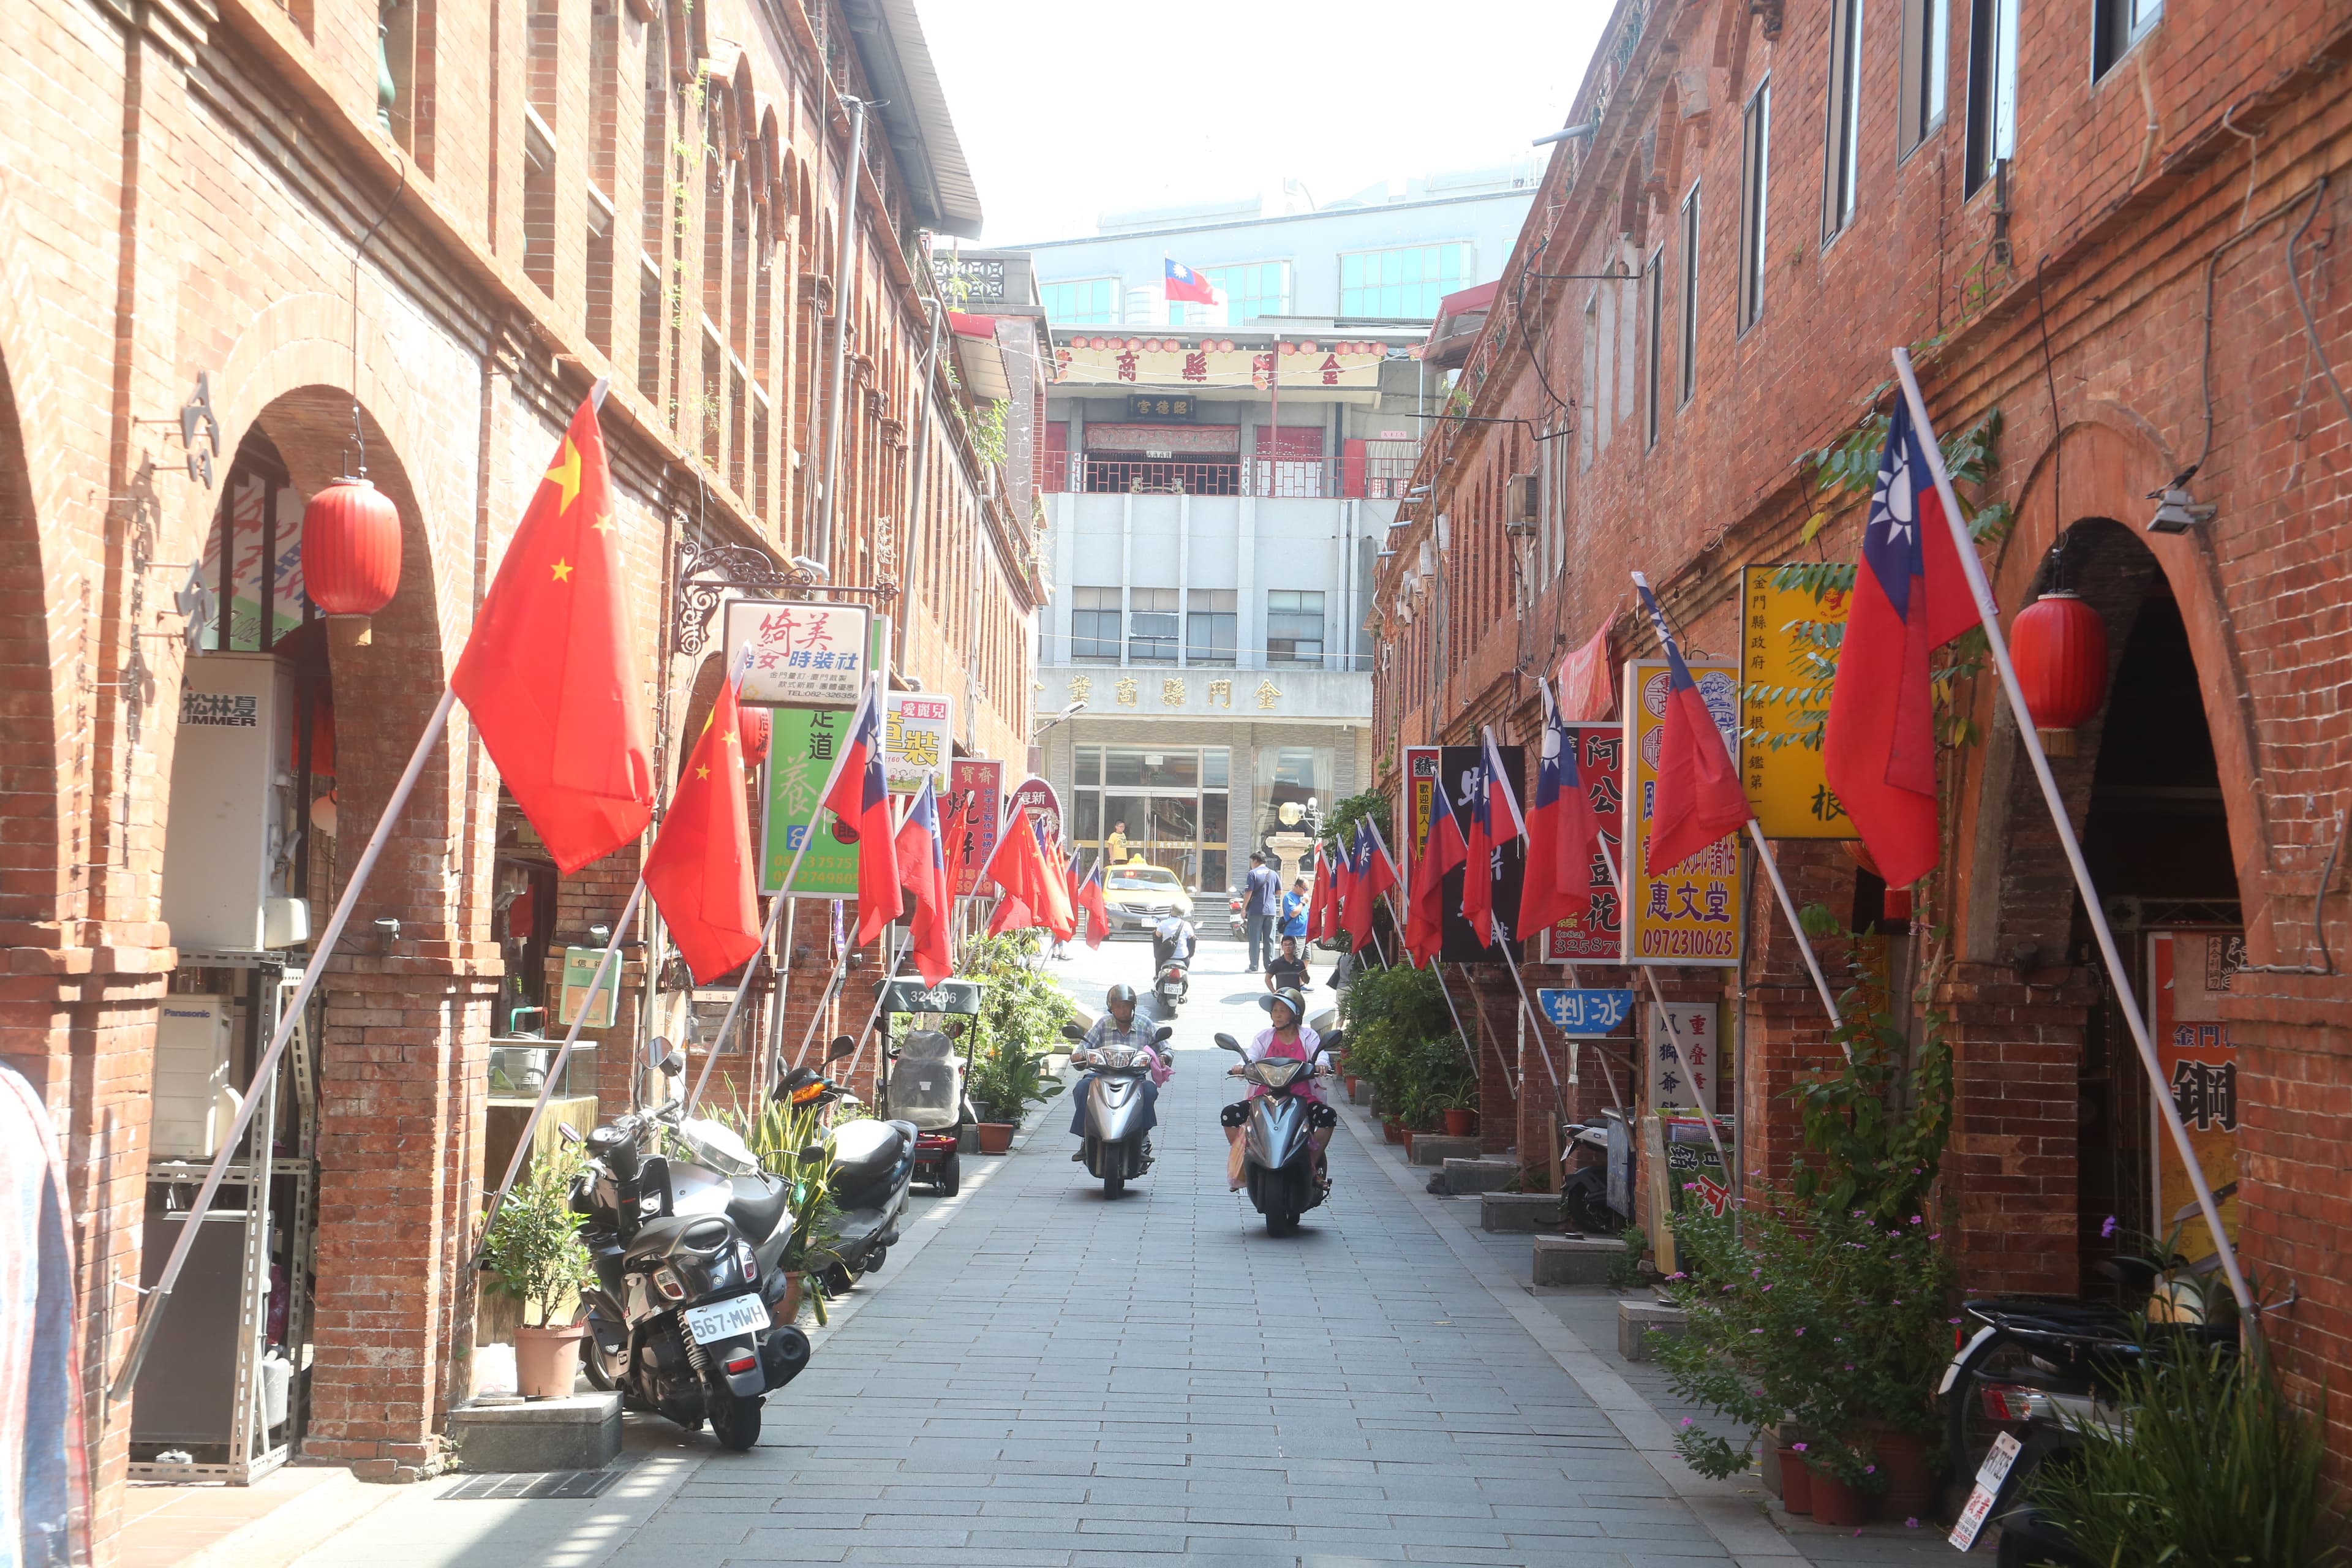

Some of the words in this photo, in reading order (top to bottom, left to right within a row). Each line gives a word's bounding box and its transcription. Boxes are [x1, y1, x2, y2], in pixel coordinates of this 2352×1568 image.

[1056, 350, 1346, 385] 金門縣商
[757, 608, 834, 657] 綺美
[1035, 675, 1283, 709] 金門縣商業
[1748, 575, 1768, 827] 金門縣政府一條根評鑑第一
[902, 703, 945, 718] 愛麗兒
[950, 766, 995, 785] 寶齋
[1646, 880, 1731, 923] 惠文堂
[1555, 930, 1586, 940] (082)
[1642, 929, 1733, 956] 0972310625
[910, 990, 957, 1003] 324206
[164, 1008, 211, 1019] Panasonic
[691, 1304, 766, 1340] 567-MWH
